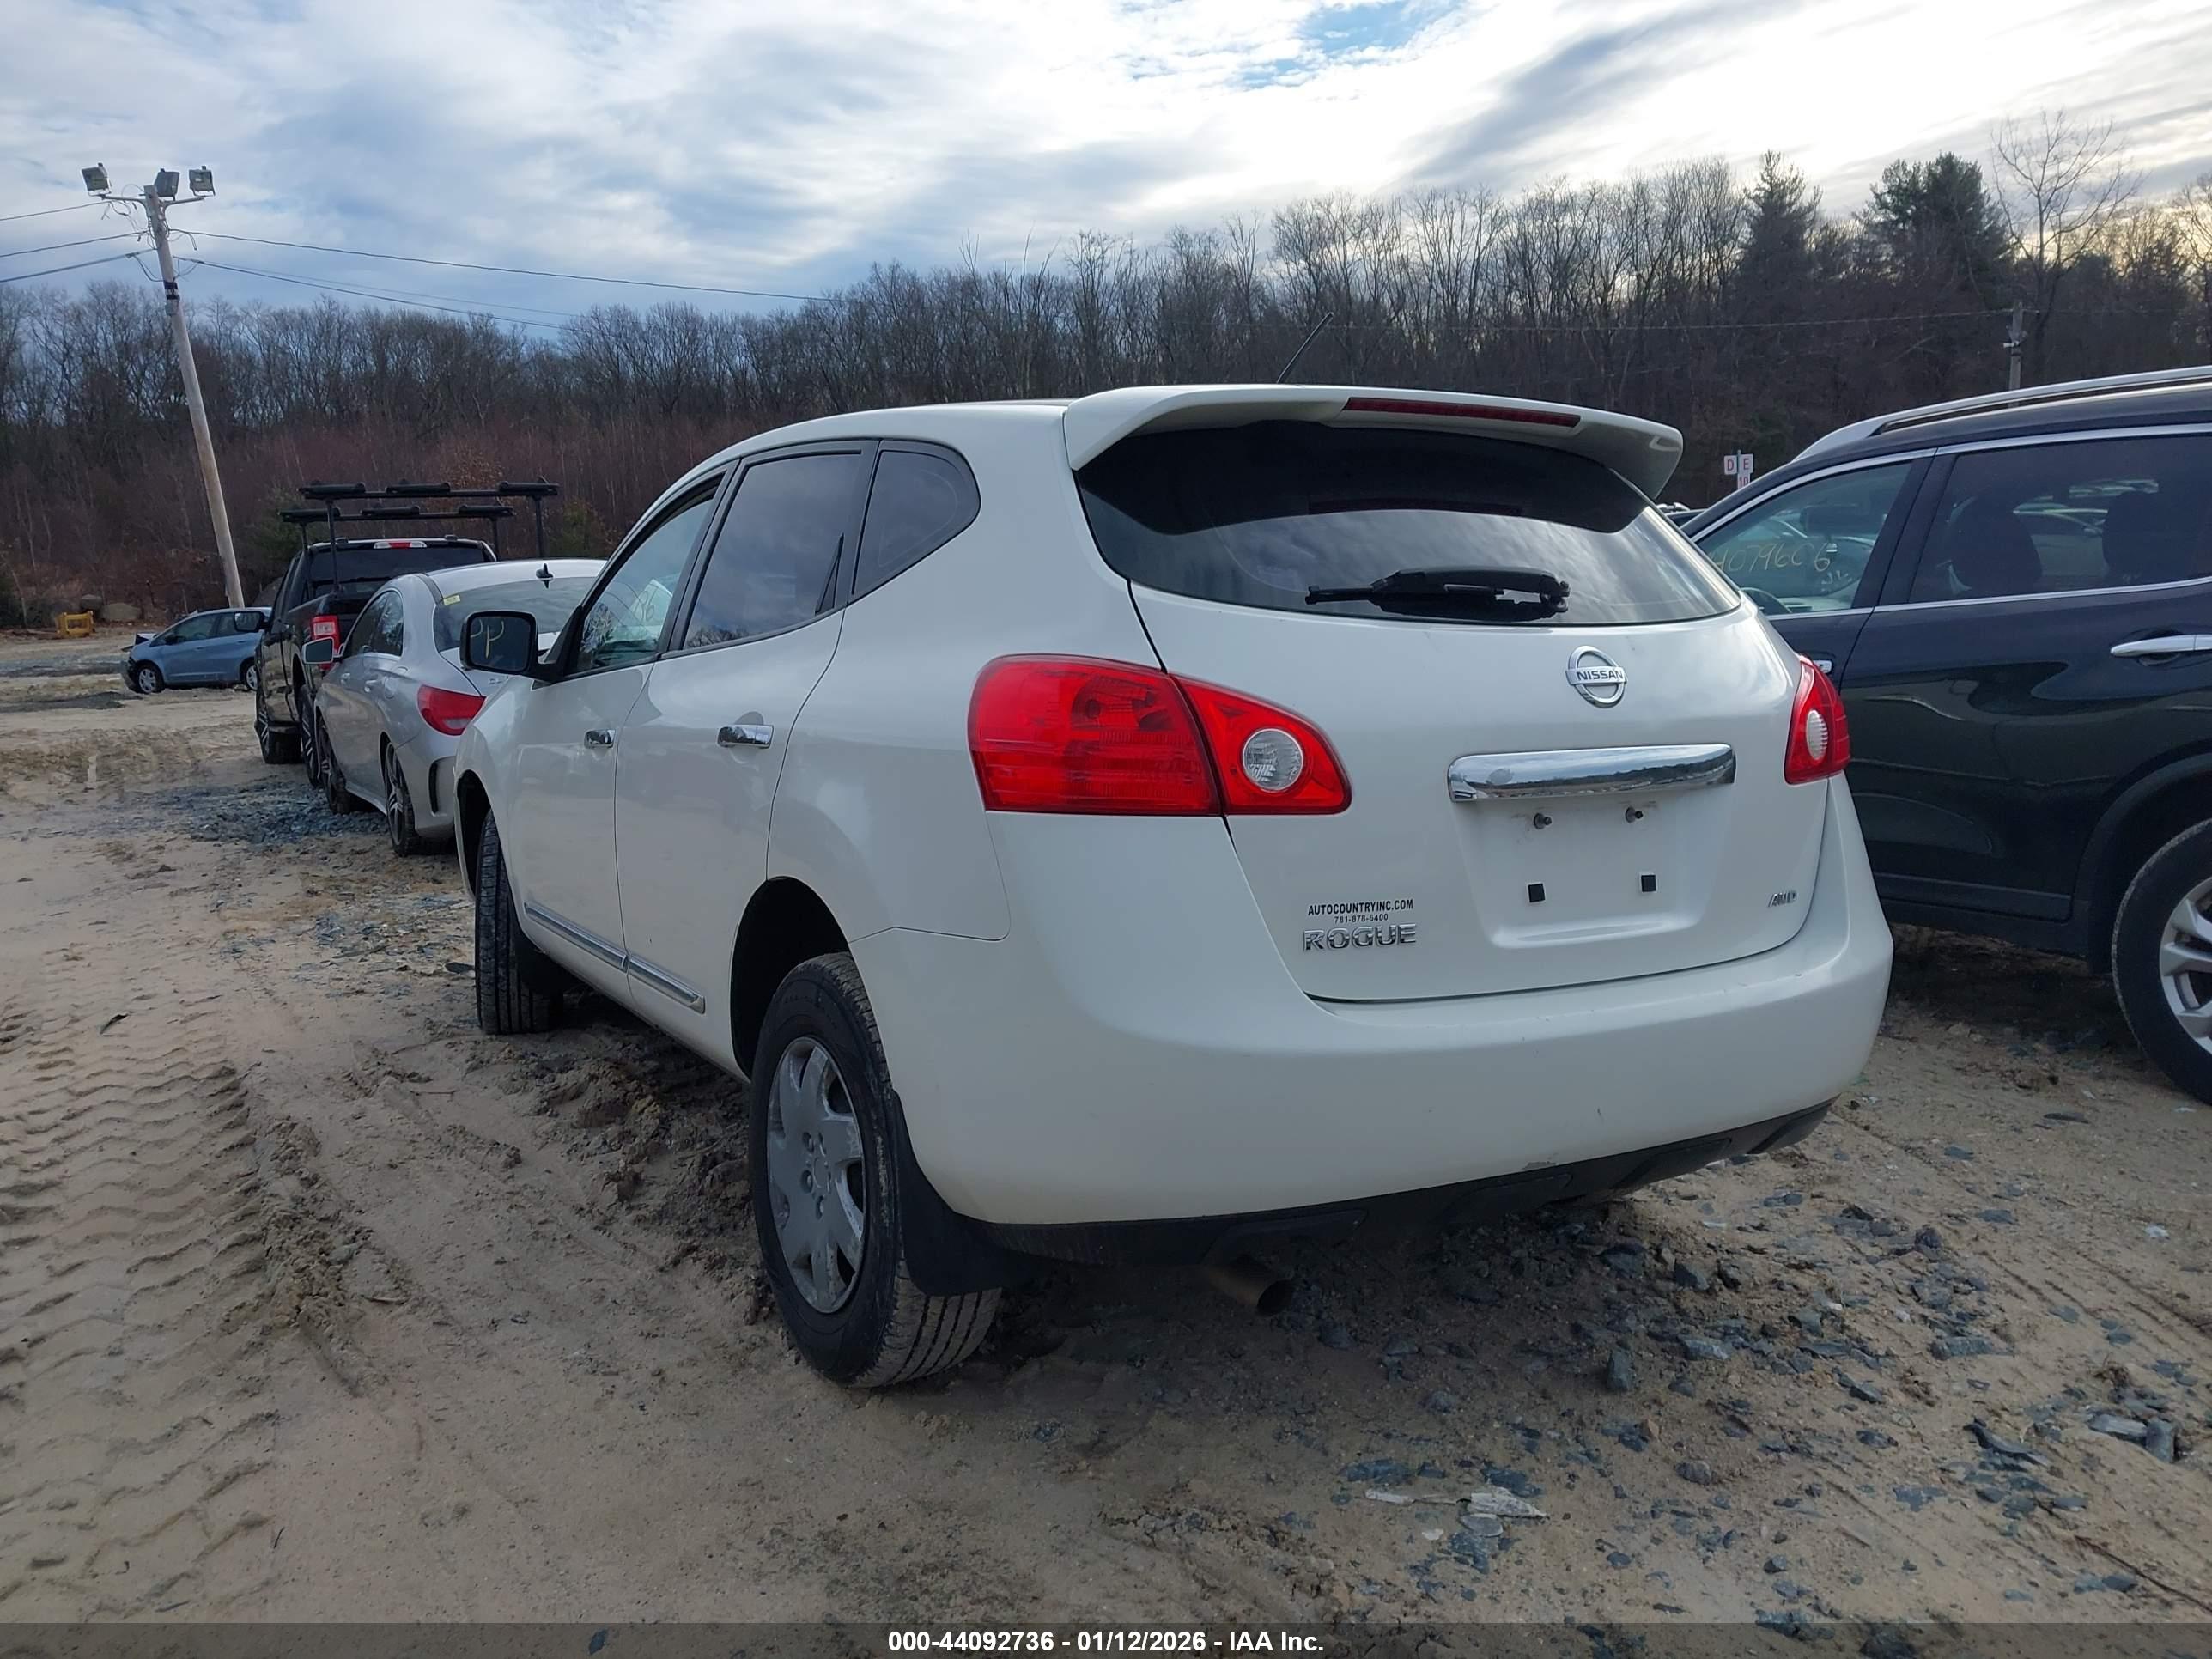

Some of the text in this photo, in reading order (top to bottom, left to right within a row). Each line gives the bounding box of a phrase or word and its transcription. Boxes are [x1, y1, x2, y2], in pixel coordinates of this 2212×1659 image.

[1727, 459, 1735, 471] D
[1743, 458, 1750, 470] E
[1577, 671, 1623, 681] NISSAN
[1308, 899, 1413, 915] AUTOCOUNTRYINC.COM
[1334, 914, 1389, 923] 781-878-6400
[1303, 923, 1416, 951] ROGUE
